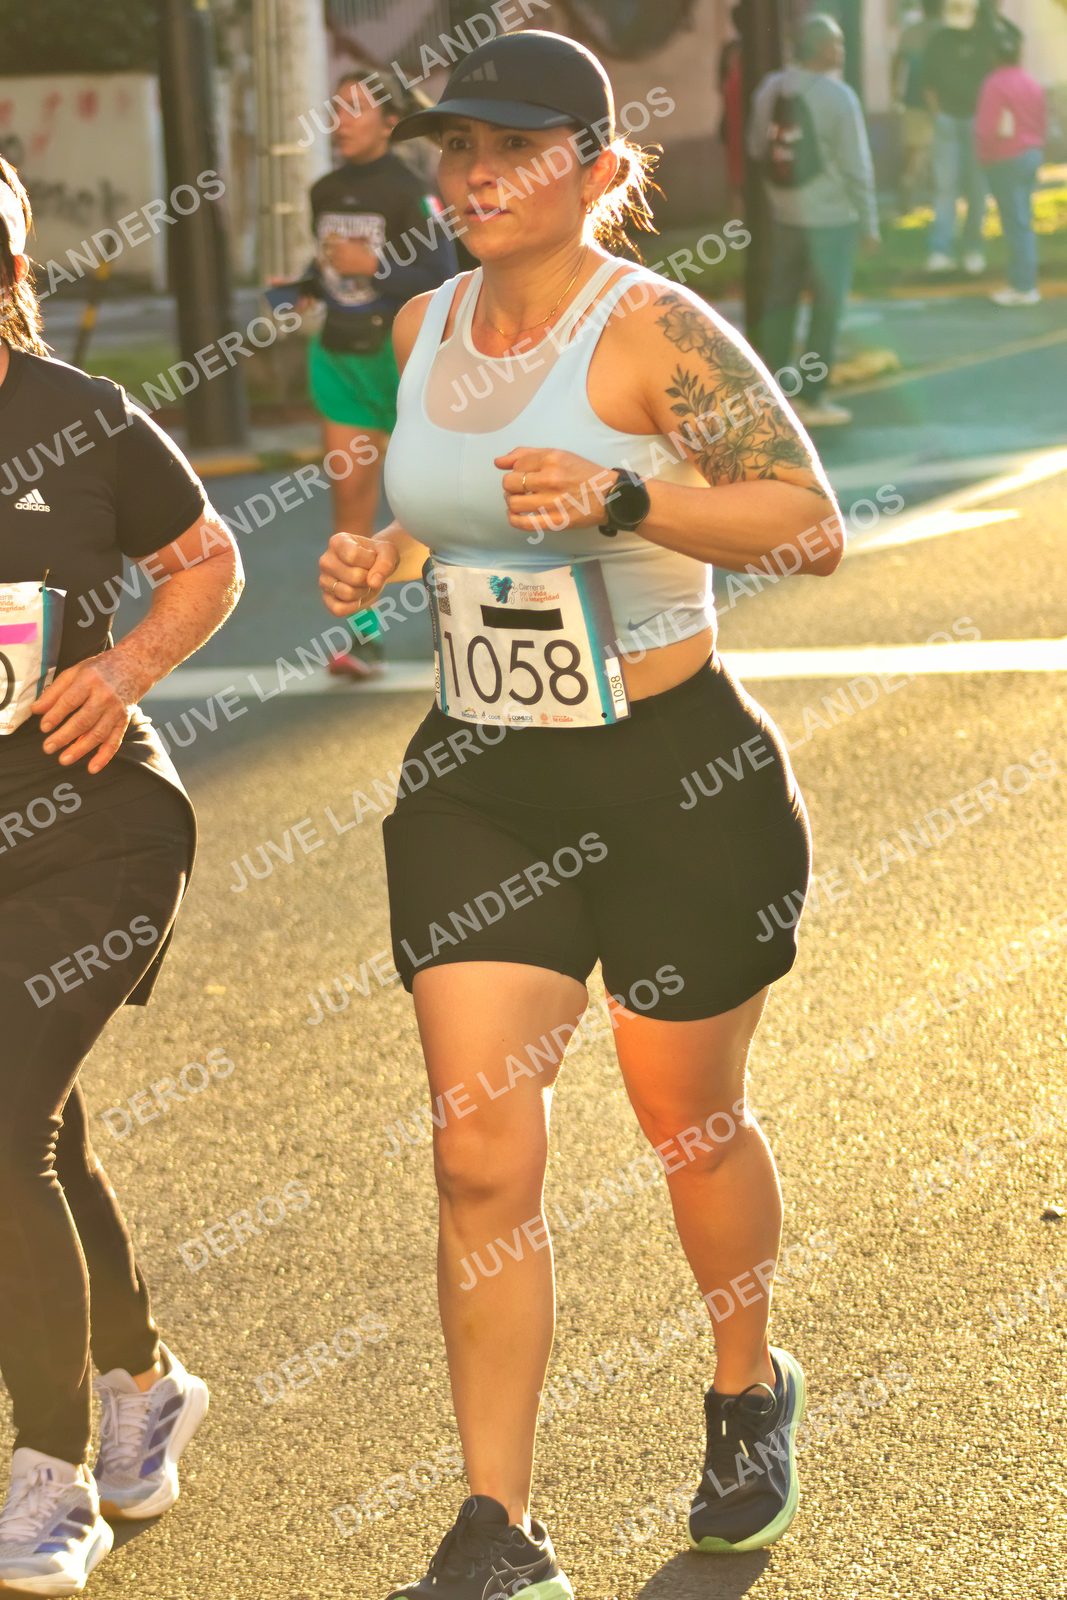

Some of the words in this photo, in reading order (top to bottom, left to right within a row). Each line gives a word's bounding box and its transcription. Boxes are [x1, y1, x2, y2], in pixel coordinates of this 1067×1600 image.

[15, 502, 50, 512] adidas
[444, 631, 588, 706] 1058
[610, 675, 624, 703] 1058
